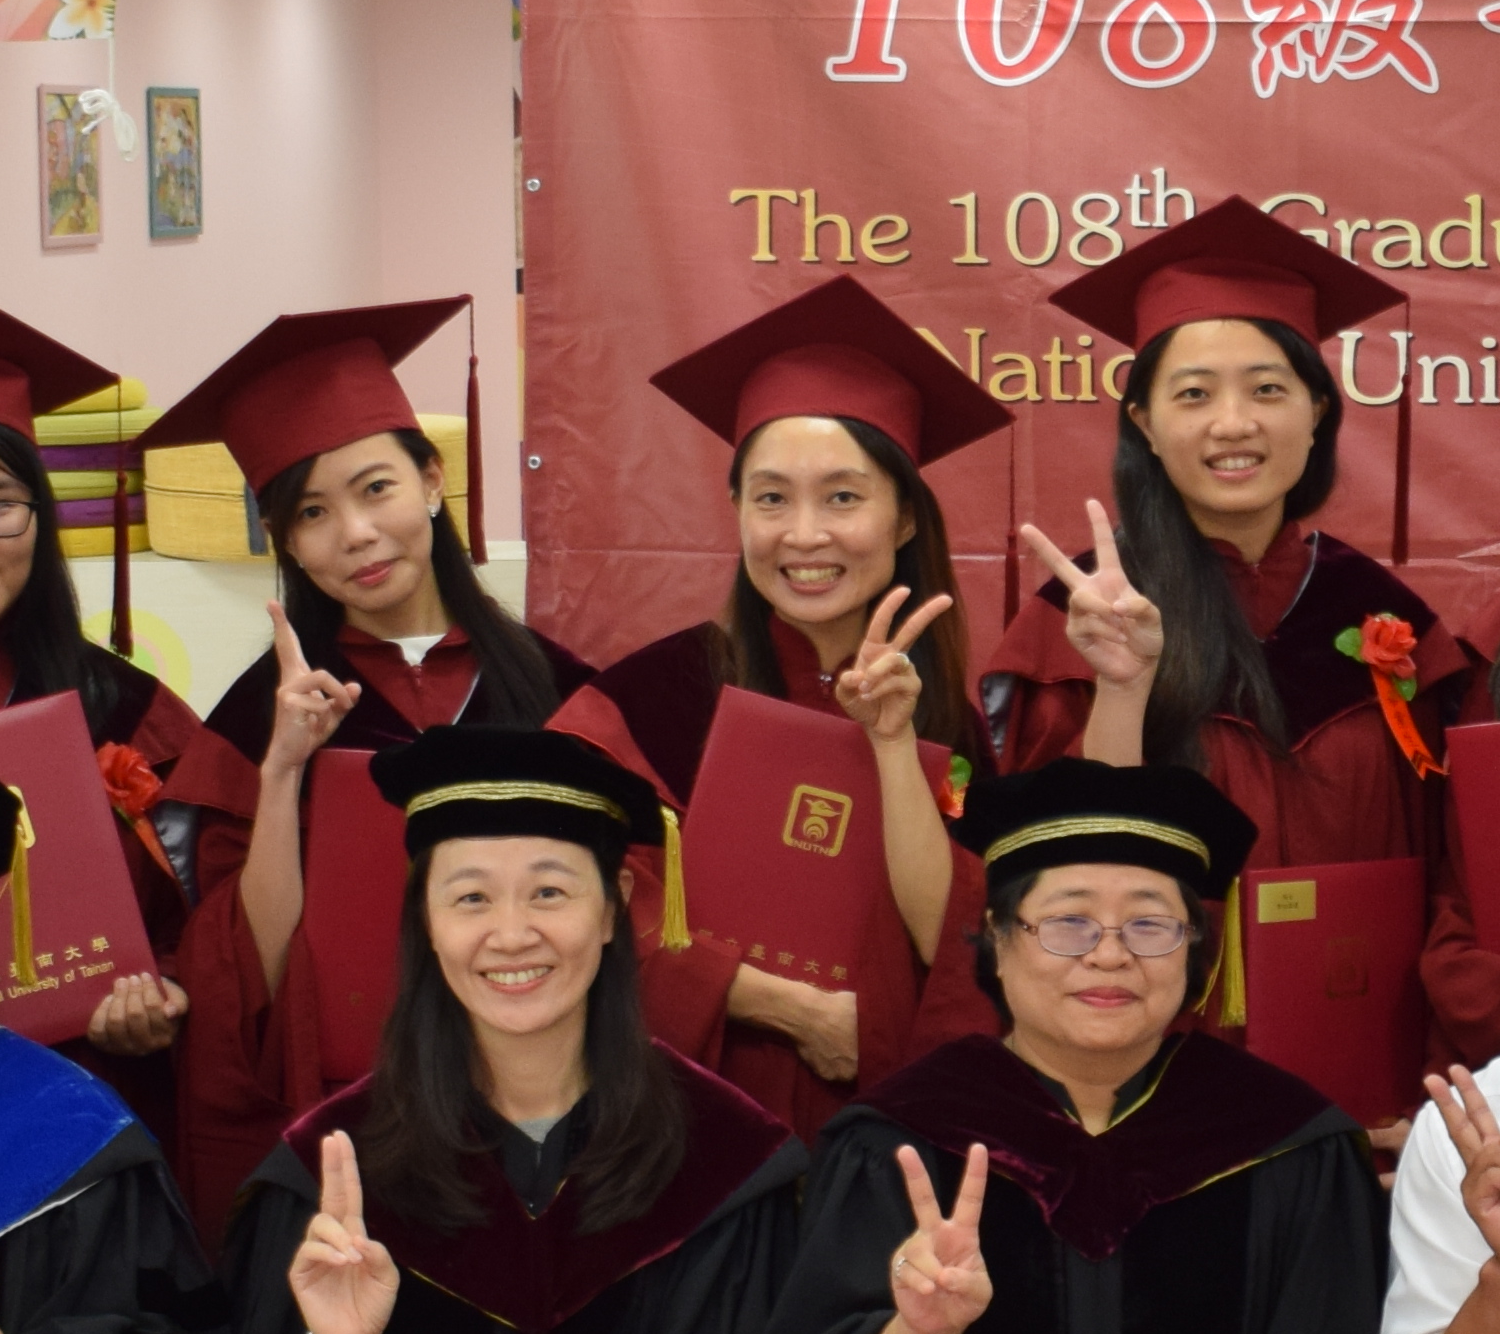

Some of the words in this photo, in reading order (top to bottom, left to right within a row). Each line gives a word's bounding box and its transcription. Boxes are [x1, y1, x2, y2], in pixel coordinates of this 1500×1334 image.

[730, 189, 909, 265] The
[948, 167, 1196, 267] 108th
[64, 969, 75, 984] of
[78, 961, 115, 979] Tainan
